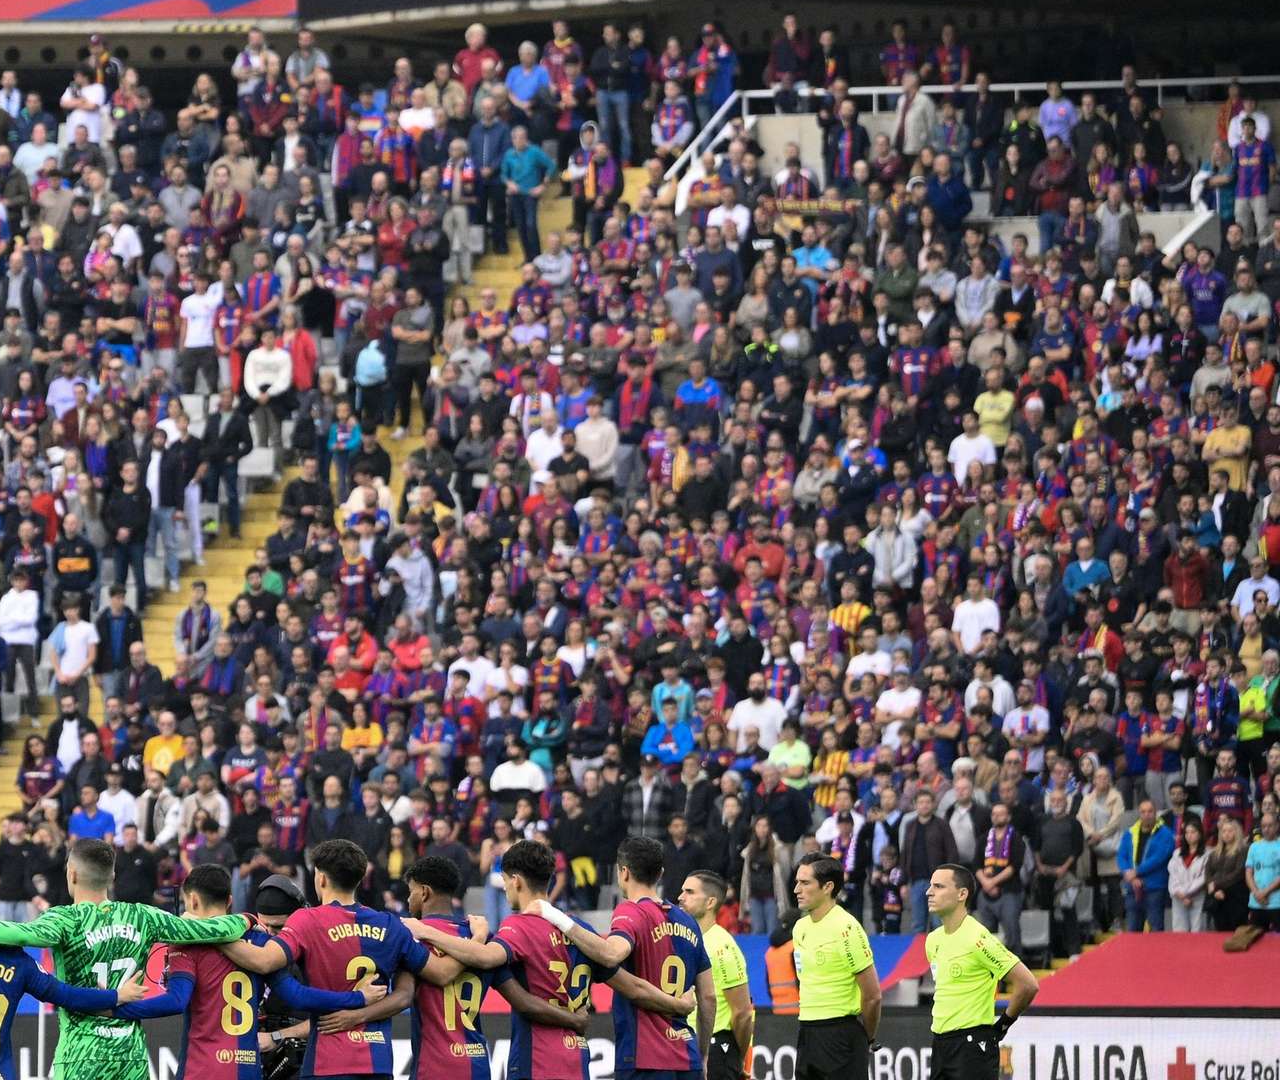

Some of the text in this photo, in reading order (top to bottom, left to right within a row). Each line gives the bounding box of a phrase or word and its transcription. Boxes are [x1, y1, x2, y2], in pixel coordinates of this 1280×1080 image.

[221, 970, 254, 1036] 8
[443, 971, 482, 1032] 19
[1204, 1059, 1245, 1080] Cruz
